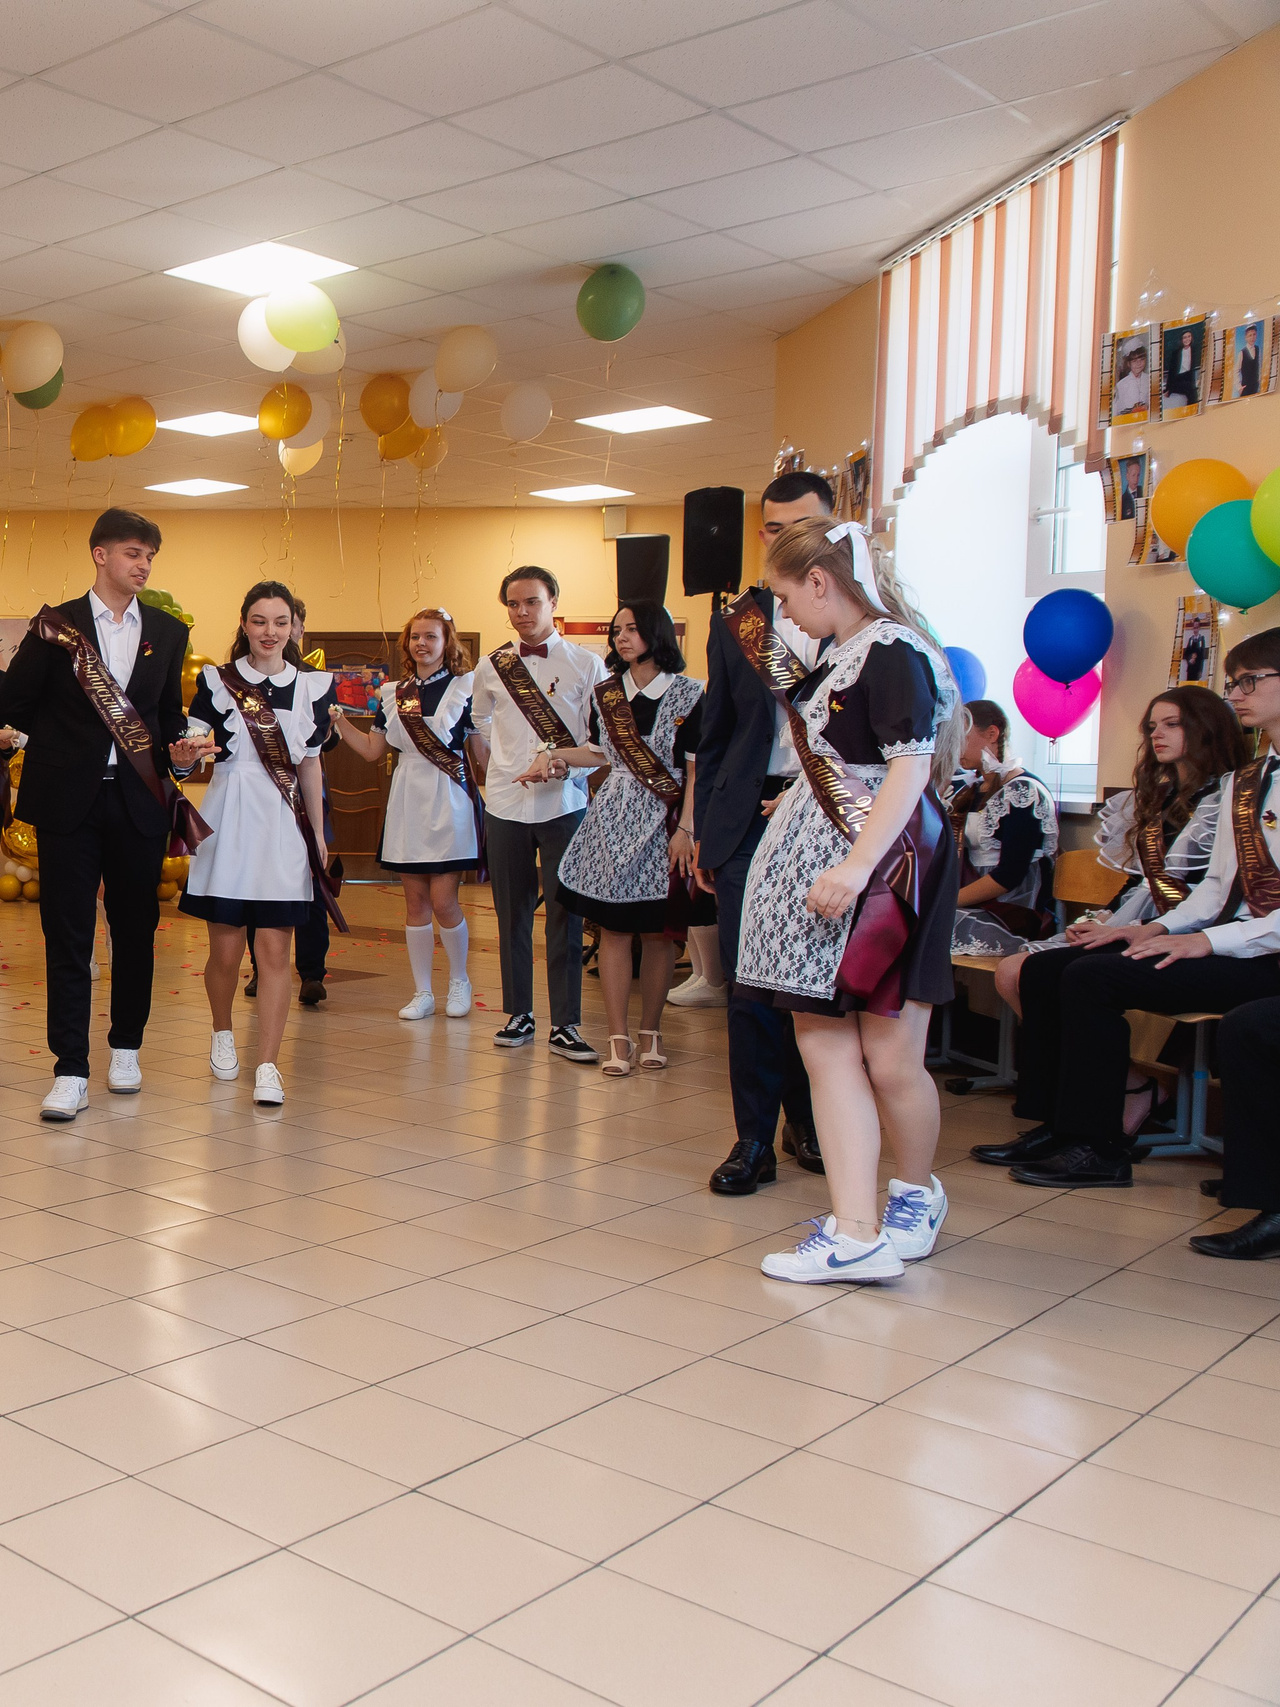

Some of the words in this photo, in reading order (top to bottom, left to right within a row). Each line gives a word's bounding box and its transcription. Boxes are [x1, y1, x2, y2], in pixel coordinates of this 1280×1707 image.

[77, 641, 128, 727] Выпускник
[120, 720, 152, 753] 2024
[509, 666, 558, 734] Выпускник
[752, 633, 797, 690] Выпу
[612, 705, 657, 775] Выпускница
[648, 772, 680, 796] 202
